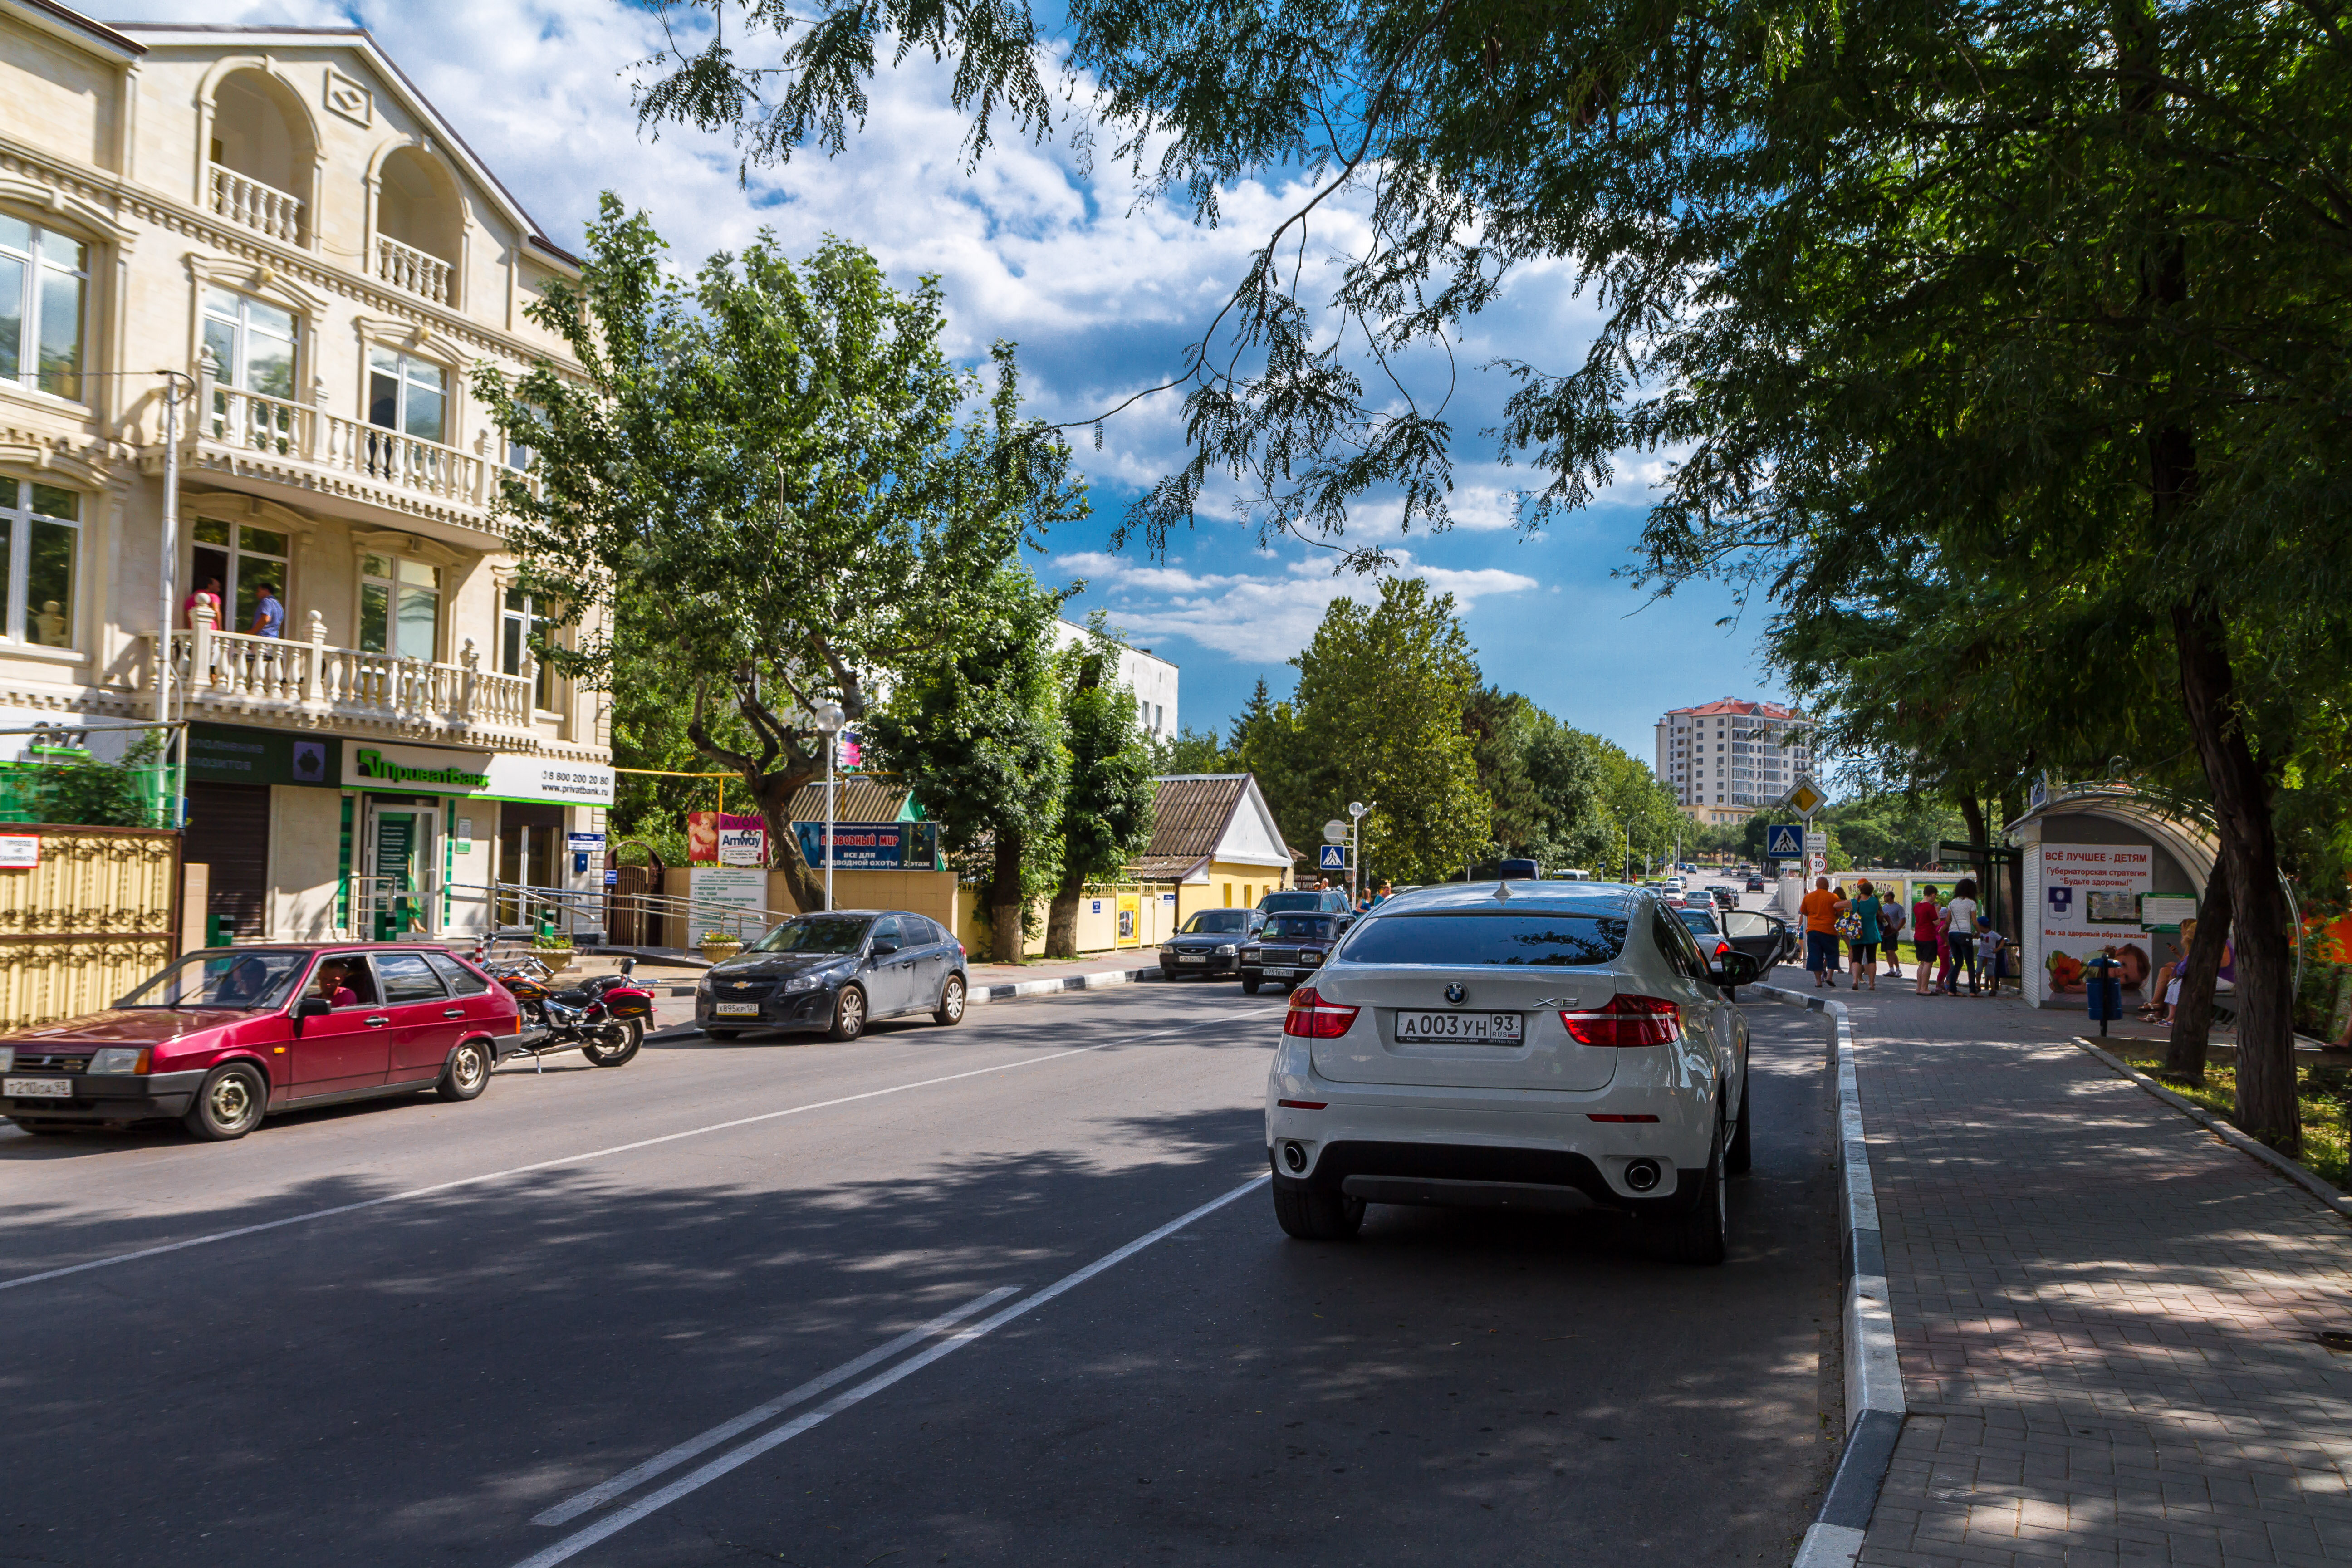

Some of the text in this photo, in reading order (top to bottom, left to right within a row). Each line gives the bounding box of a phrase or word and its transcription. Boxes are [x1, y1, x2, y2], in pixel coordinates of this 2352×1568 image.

[381, 761, 491, 786] ПриватБанк
[549, 771, 554, 780] 8
[556, 772, 570, 781] 800
[573, 774, 586, 783] 200
[589, 775, 598, 784] 20
[542, 784, 609, 796] www.privatbank.ru
[723, 818, 760, 827] AVON
[722, 834, 760, 848] Amway
[821, 833, 899, 846] ПДВОДНЫЙ МИР
[2045, 851, 2064, 861] ВСЁ
[2066, 853, 2106, 862] ЛУЧШЕЕ
[2114, 854, 2147, 863] ДЕТЯМ
[2047, 867, 2107, 877] Губернаторская
[1405, 1015, 1514, 1036] А003УН 93
